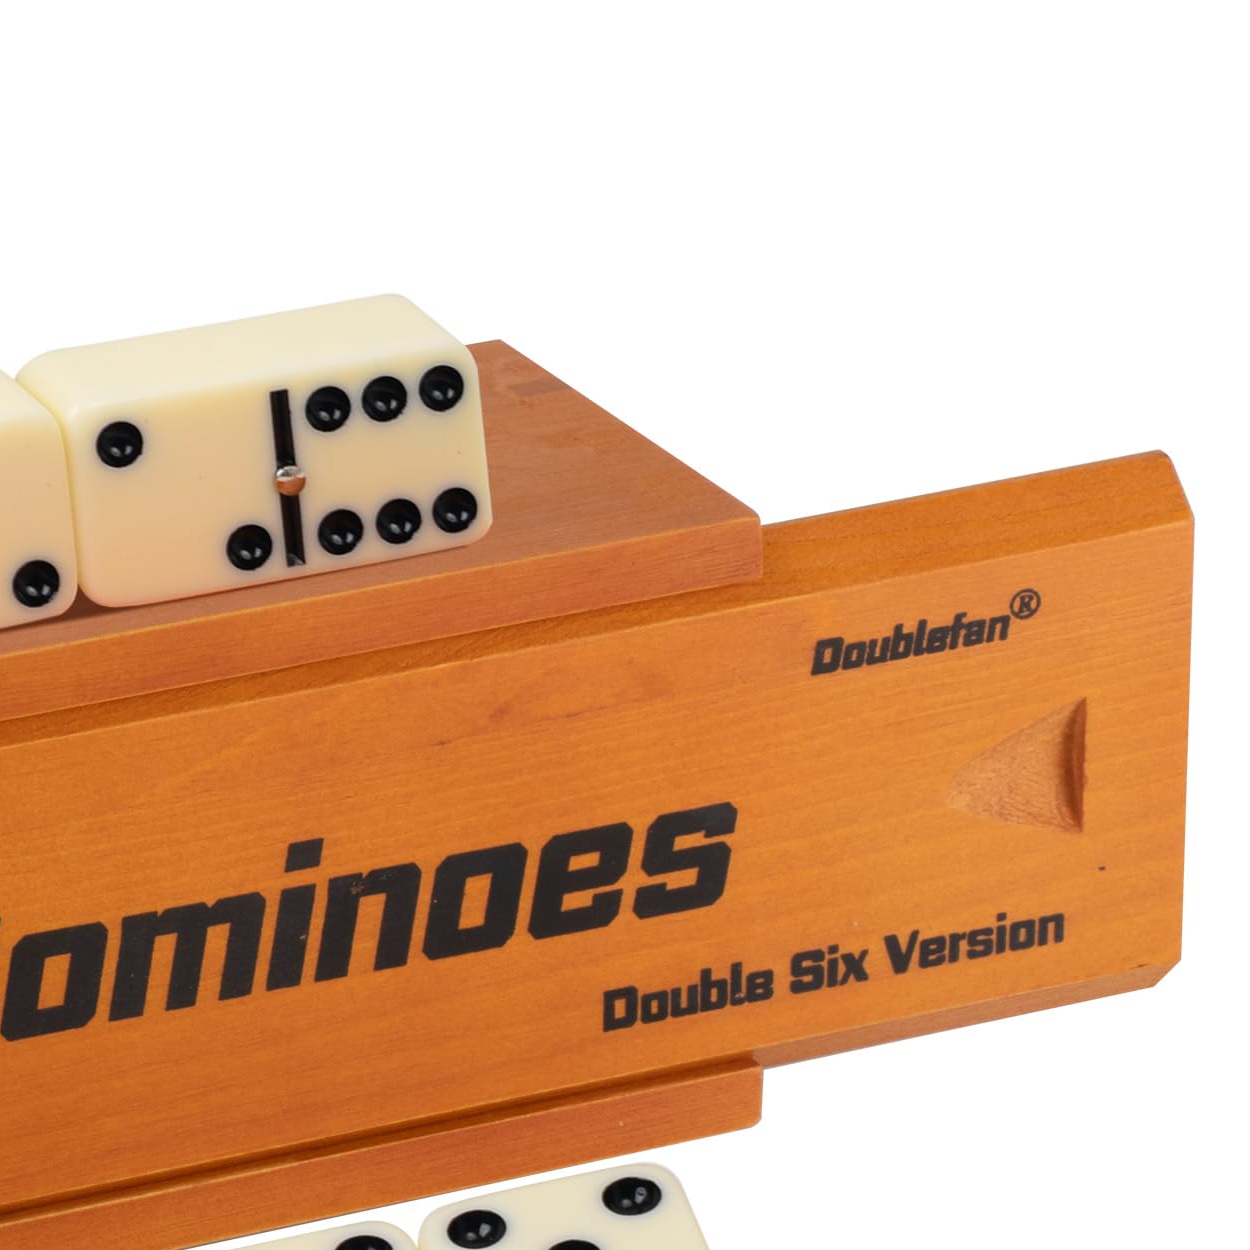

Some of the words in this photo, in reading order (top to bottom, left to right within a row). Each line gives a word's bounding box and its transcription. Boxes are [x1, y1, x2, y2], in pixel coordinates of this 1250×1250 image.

[602, 961, 775, 1033] Double
[789, 945, 870, 994] Six
[884, 912, 1065, 975] Version
